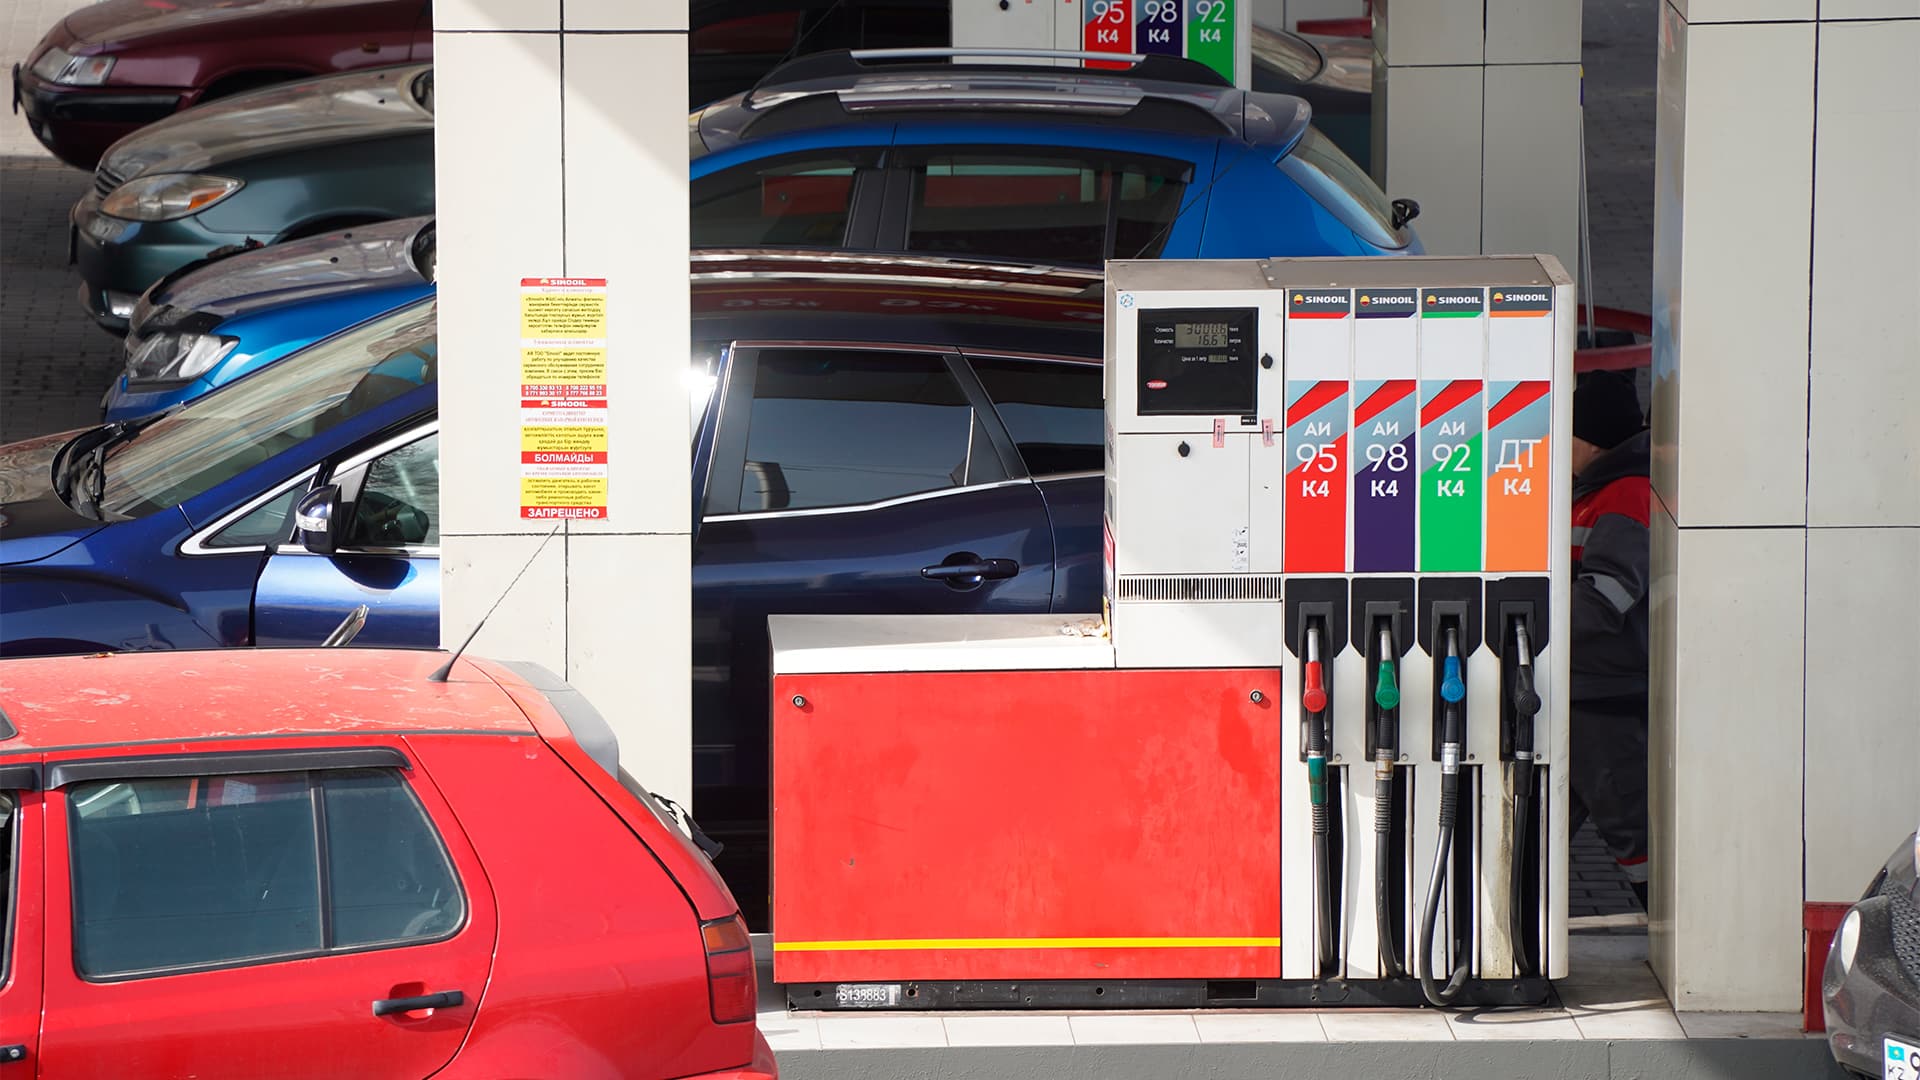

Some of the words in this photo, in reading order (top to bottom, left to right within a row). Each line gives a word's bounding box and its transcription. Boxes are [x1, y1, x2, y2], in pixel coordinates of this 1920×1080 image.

[1092, 0, 1125, 24] 95
[1144, 0, 1178, 24] 98
[1195, 0, 1226, 24] 92
[1097, 29, 1119, 43] К4
[1148, 29, 1170, 43] К4
[1200, 29, 1222, 43] К4
[1305, 295, 1349, 304] SINOOIL
[1371, 296, 1415, 305] SINOOIL
[1438, 296, 1481, 304] SINOOIL
[1505, 293, 1549, 302] SINOOIL
[1304, 421, 1331, 436] АИ
[1372, 421, 1399, 436] АИ
[1438, 421, 1466, 436] АИ
[534, 453, 594, 463] БОЛМАЙДЫ
[1296, 443, 1338, 473] 95
[1366, 443, 1409, 472] 98
[1432, 443, 1471, 472] 92
[1495, 439, 1542, 473] ДТ
[1302, 480, 1330, 497] К4
[1371, 480, 1399, 497] К4
[1437, 480, 1465, 497] К4
[1503, 478, 1532, 495] К4
[528, 508, 600, 518] ЗАПРЕЩЕНО
